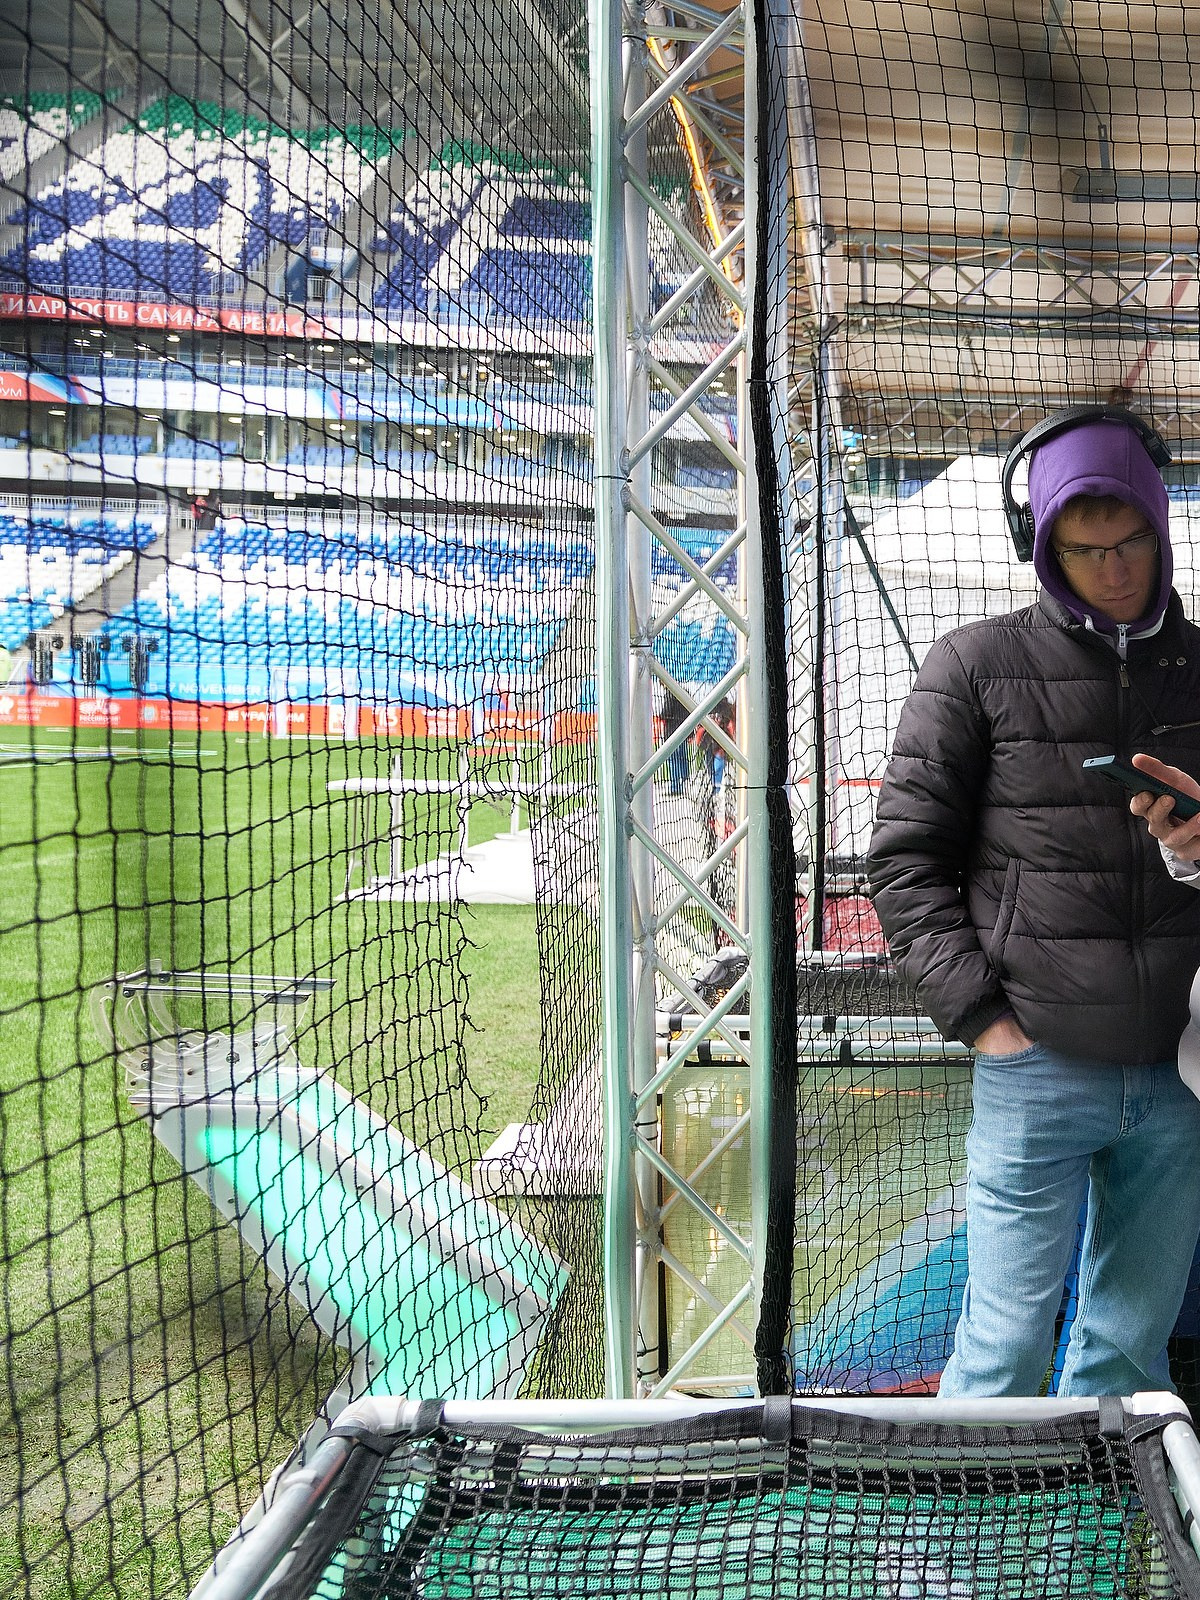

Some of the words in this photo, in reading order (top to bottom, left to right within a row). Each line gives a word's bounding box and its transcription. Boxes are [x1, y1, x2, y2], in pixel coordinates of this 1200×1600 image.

[136, 306, 219, 328] САМАРА
[228, 314, 291, 333] АРЕНА
[0, 387, 22, 397] УМ
[179, 683, 262, 696] NOVEMBER
